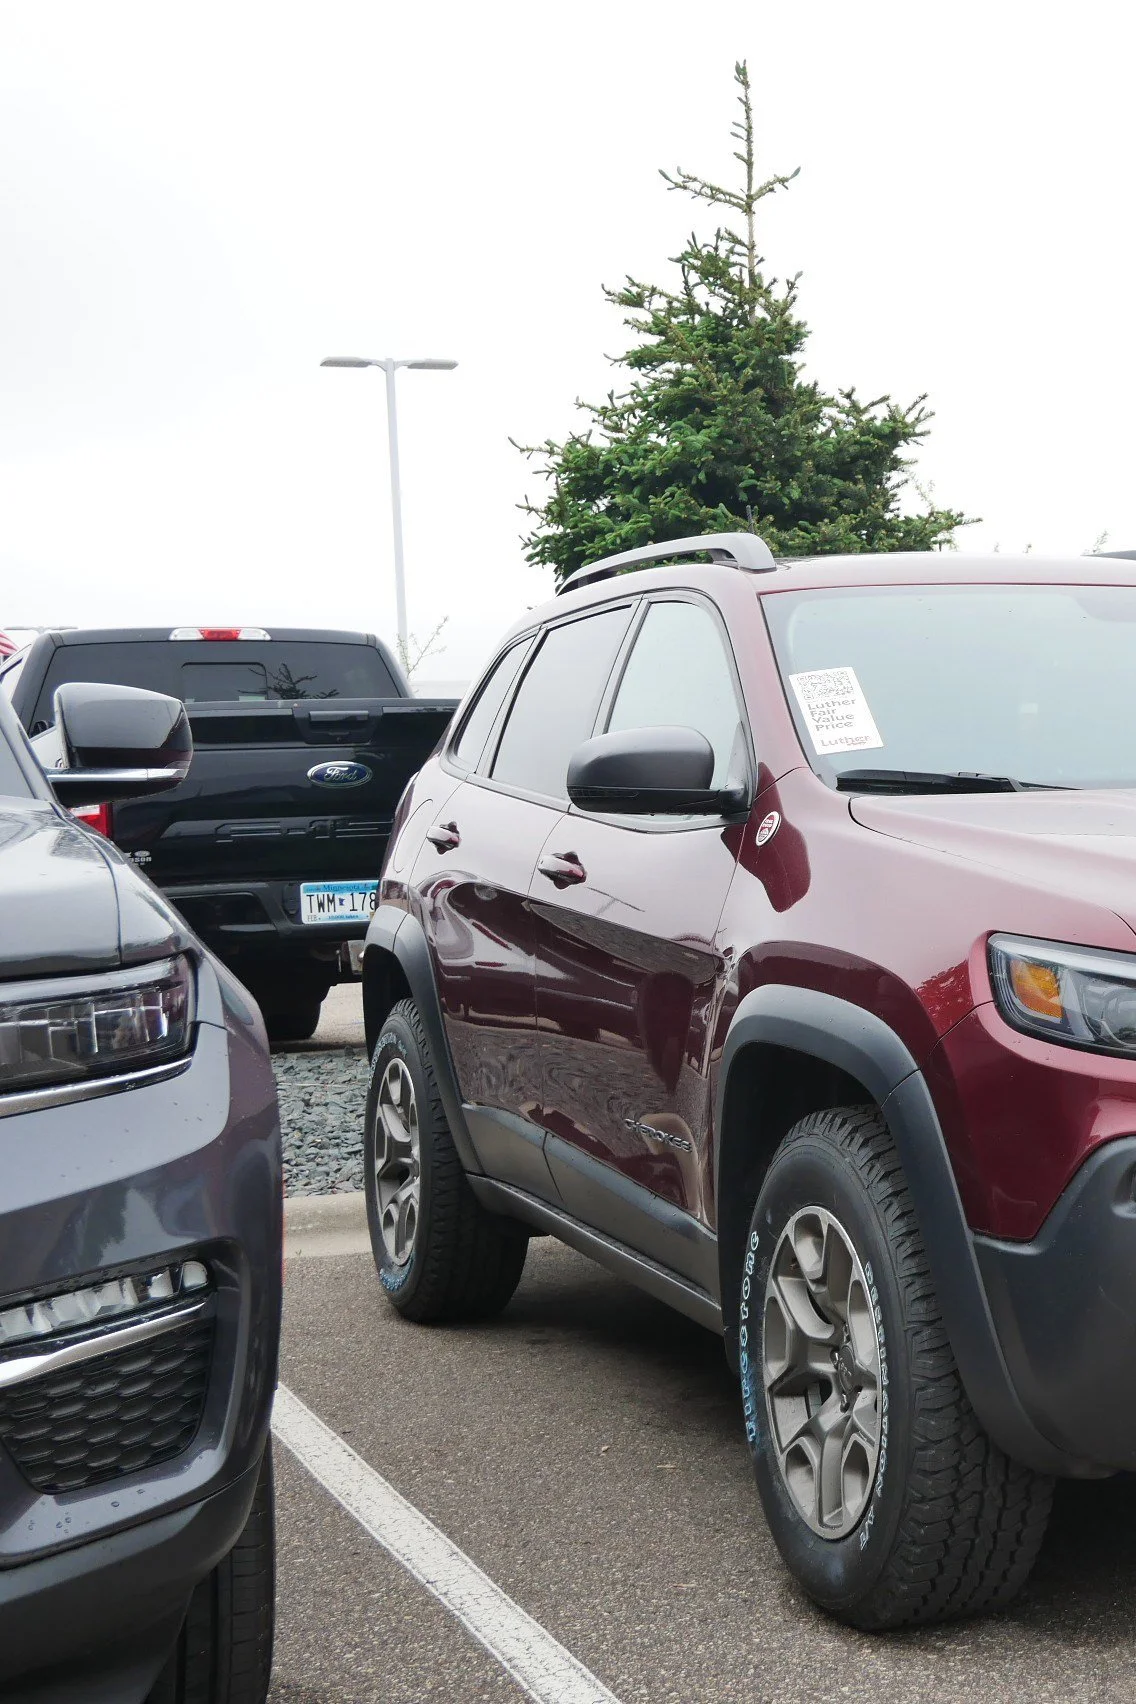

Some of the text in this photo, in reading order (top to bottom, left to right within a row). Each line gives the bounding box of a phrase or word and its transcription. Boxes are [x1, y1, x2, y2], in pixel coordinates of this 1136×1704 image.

[807, 699, 857, 710] Luther
[810, 709, 837, 717] Fair
[812, 714, 855, 724] Value
[815, 721, 854, 731] Price
[820, 735, 871, 747] Luther
[323, 766, 358, 781] Ford
[323, 884, 360, 892] Minnesota
[306, 893, 336, 913] TWM
[623, 1118, 693, 1153] CHEROKEE
